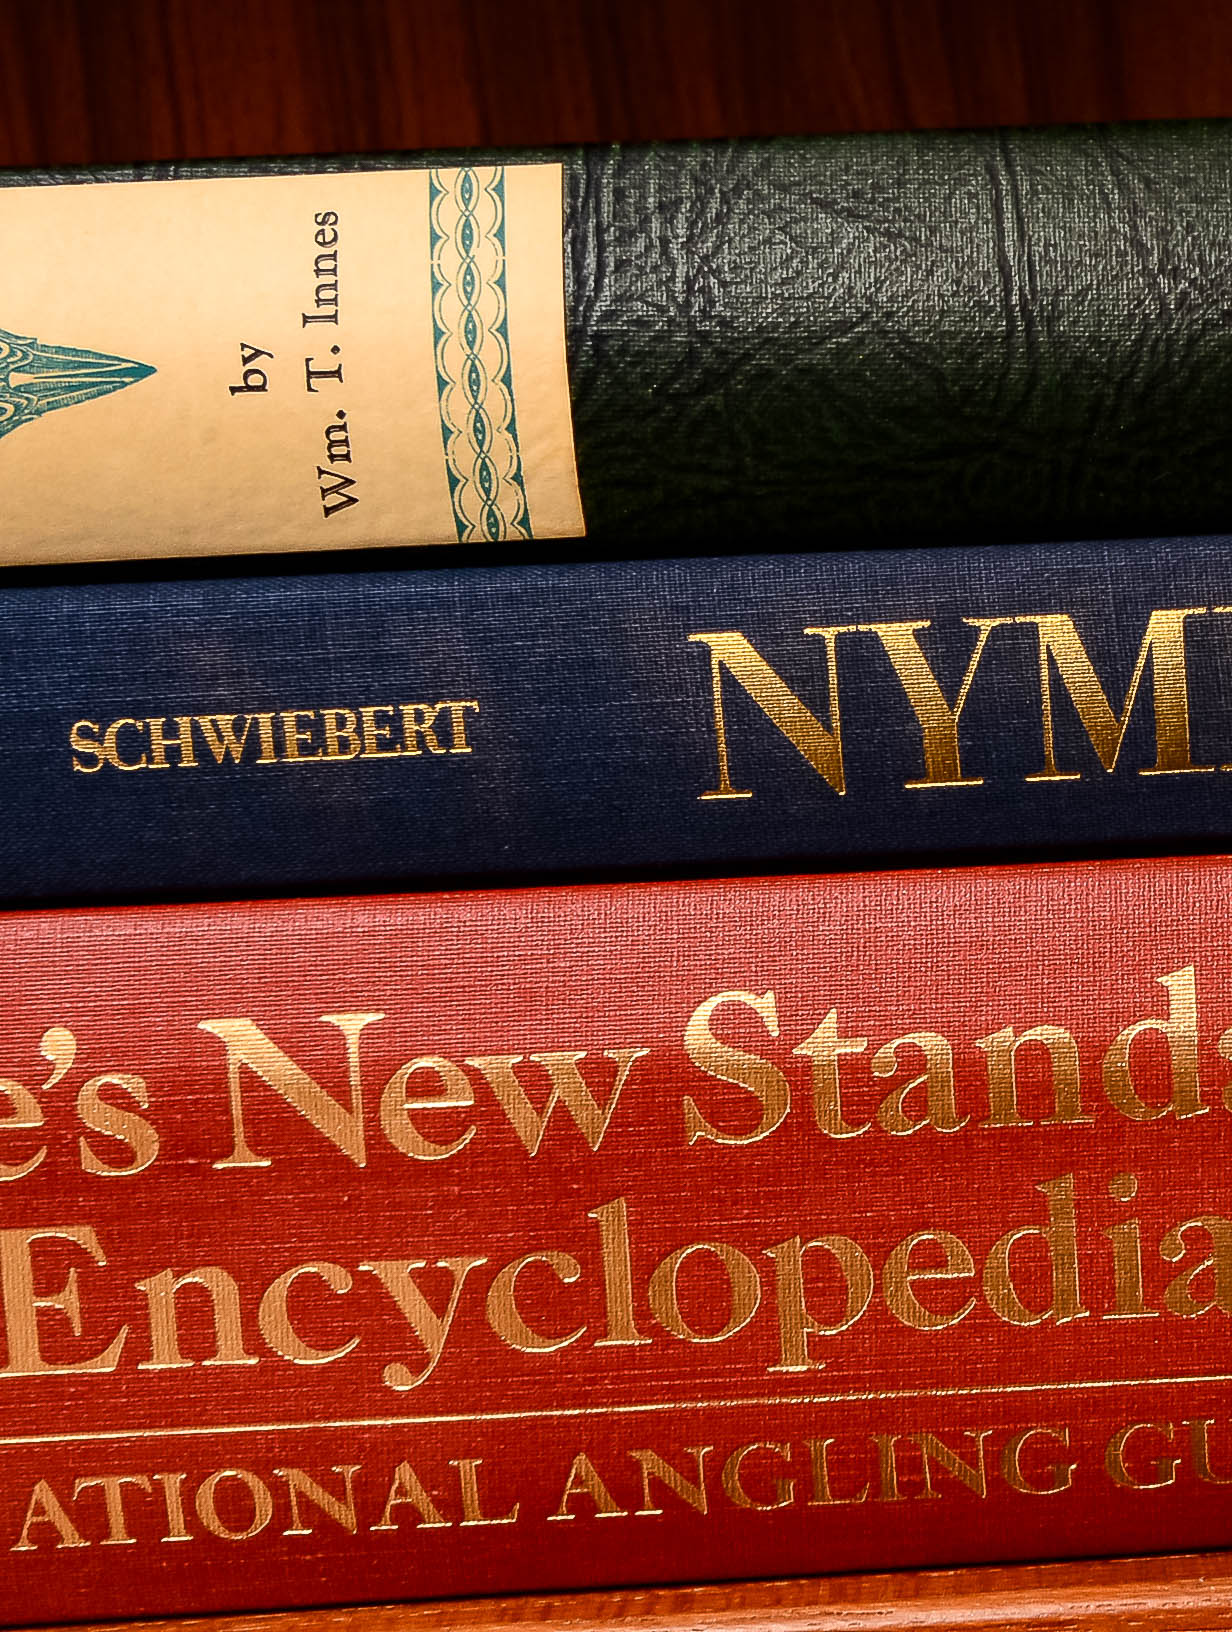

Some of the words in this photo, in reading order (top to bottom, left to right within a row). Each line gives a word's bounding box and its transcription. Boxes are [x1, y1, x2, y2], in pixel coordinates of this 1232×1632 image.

[301, 210, 340, 329] Innes
[229, 342, 274, 395] by
[305, 344, 345, 393] T.
[316, 408, 360, 518] Wm.
[69, 699, 480, 774] SCHWIEBERT
[198, 1012, 651, 1170] New
[9, 1457, 520, 1553] ATIONAL
[546, 1427, 1078, 1526] ANGLING
